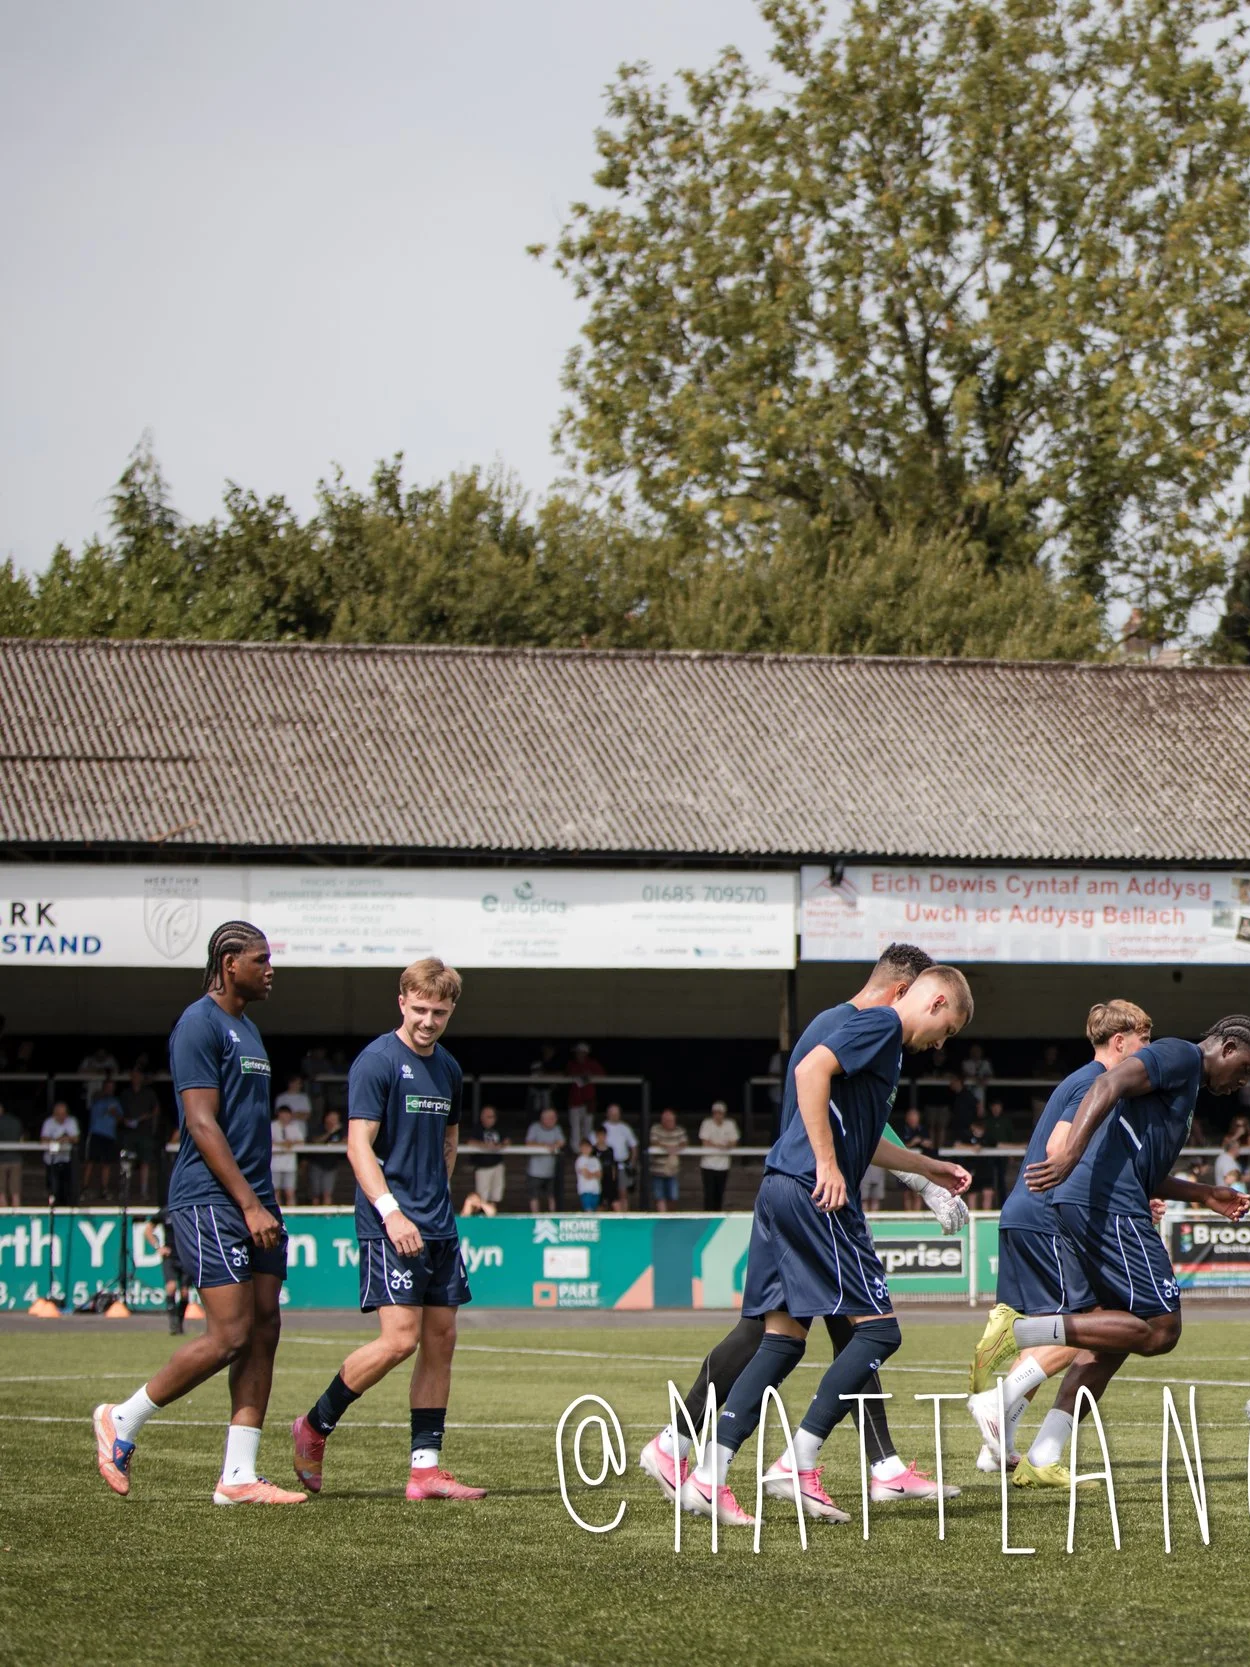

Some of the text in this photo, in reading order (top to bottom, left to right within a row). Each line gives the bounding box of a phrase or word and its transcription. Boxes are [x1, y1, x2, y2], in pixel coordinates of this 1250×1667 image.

[641, 884, 767, 903] 01685 709570
[871, 873, 1212, 900] Eich Dewis Cyntaf am Addysg
[0, 901, 57, 927] RK
[905, 904, 1186, 928] Uwch ac Addysg Bellach
[2, 934, 102, 955] STAND
[559, 1220, 599, 1232] HOME
[78, 1222, 115, 1267] Y
[73, 1281, 90, 1305] 5
[559, 1284, 599, 1298] PART
